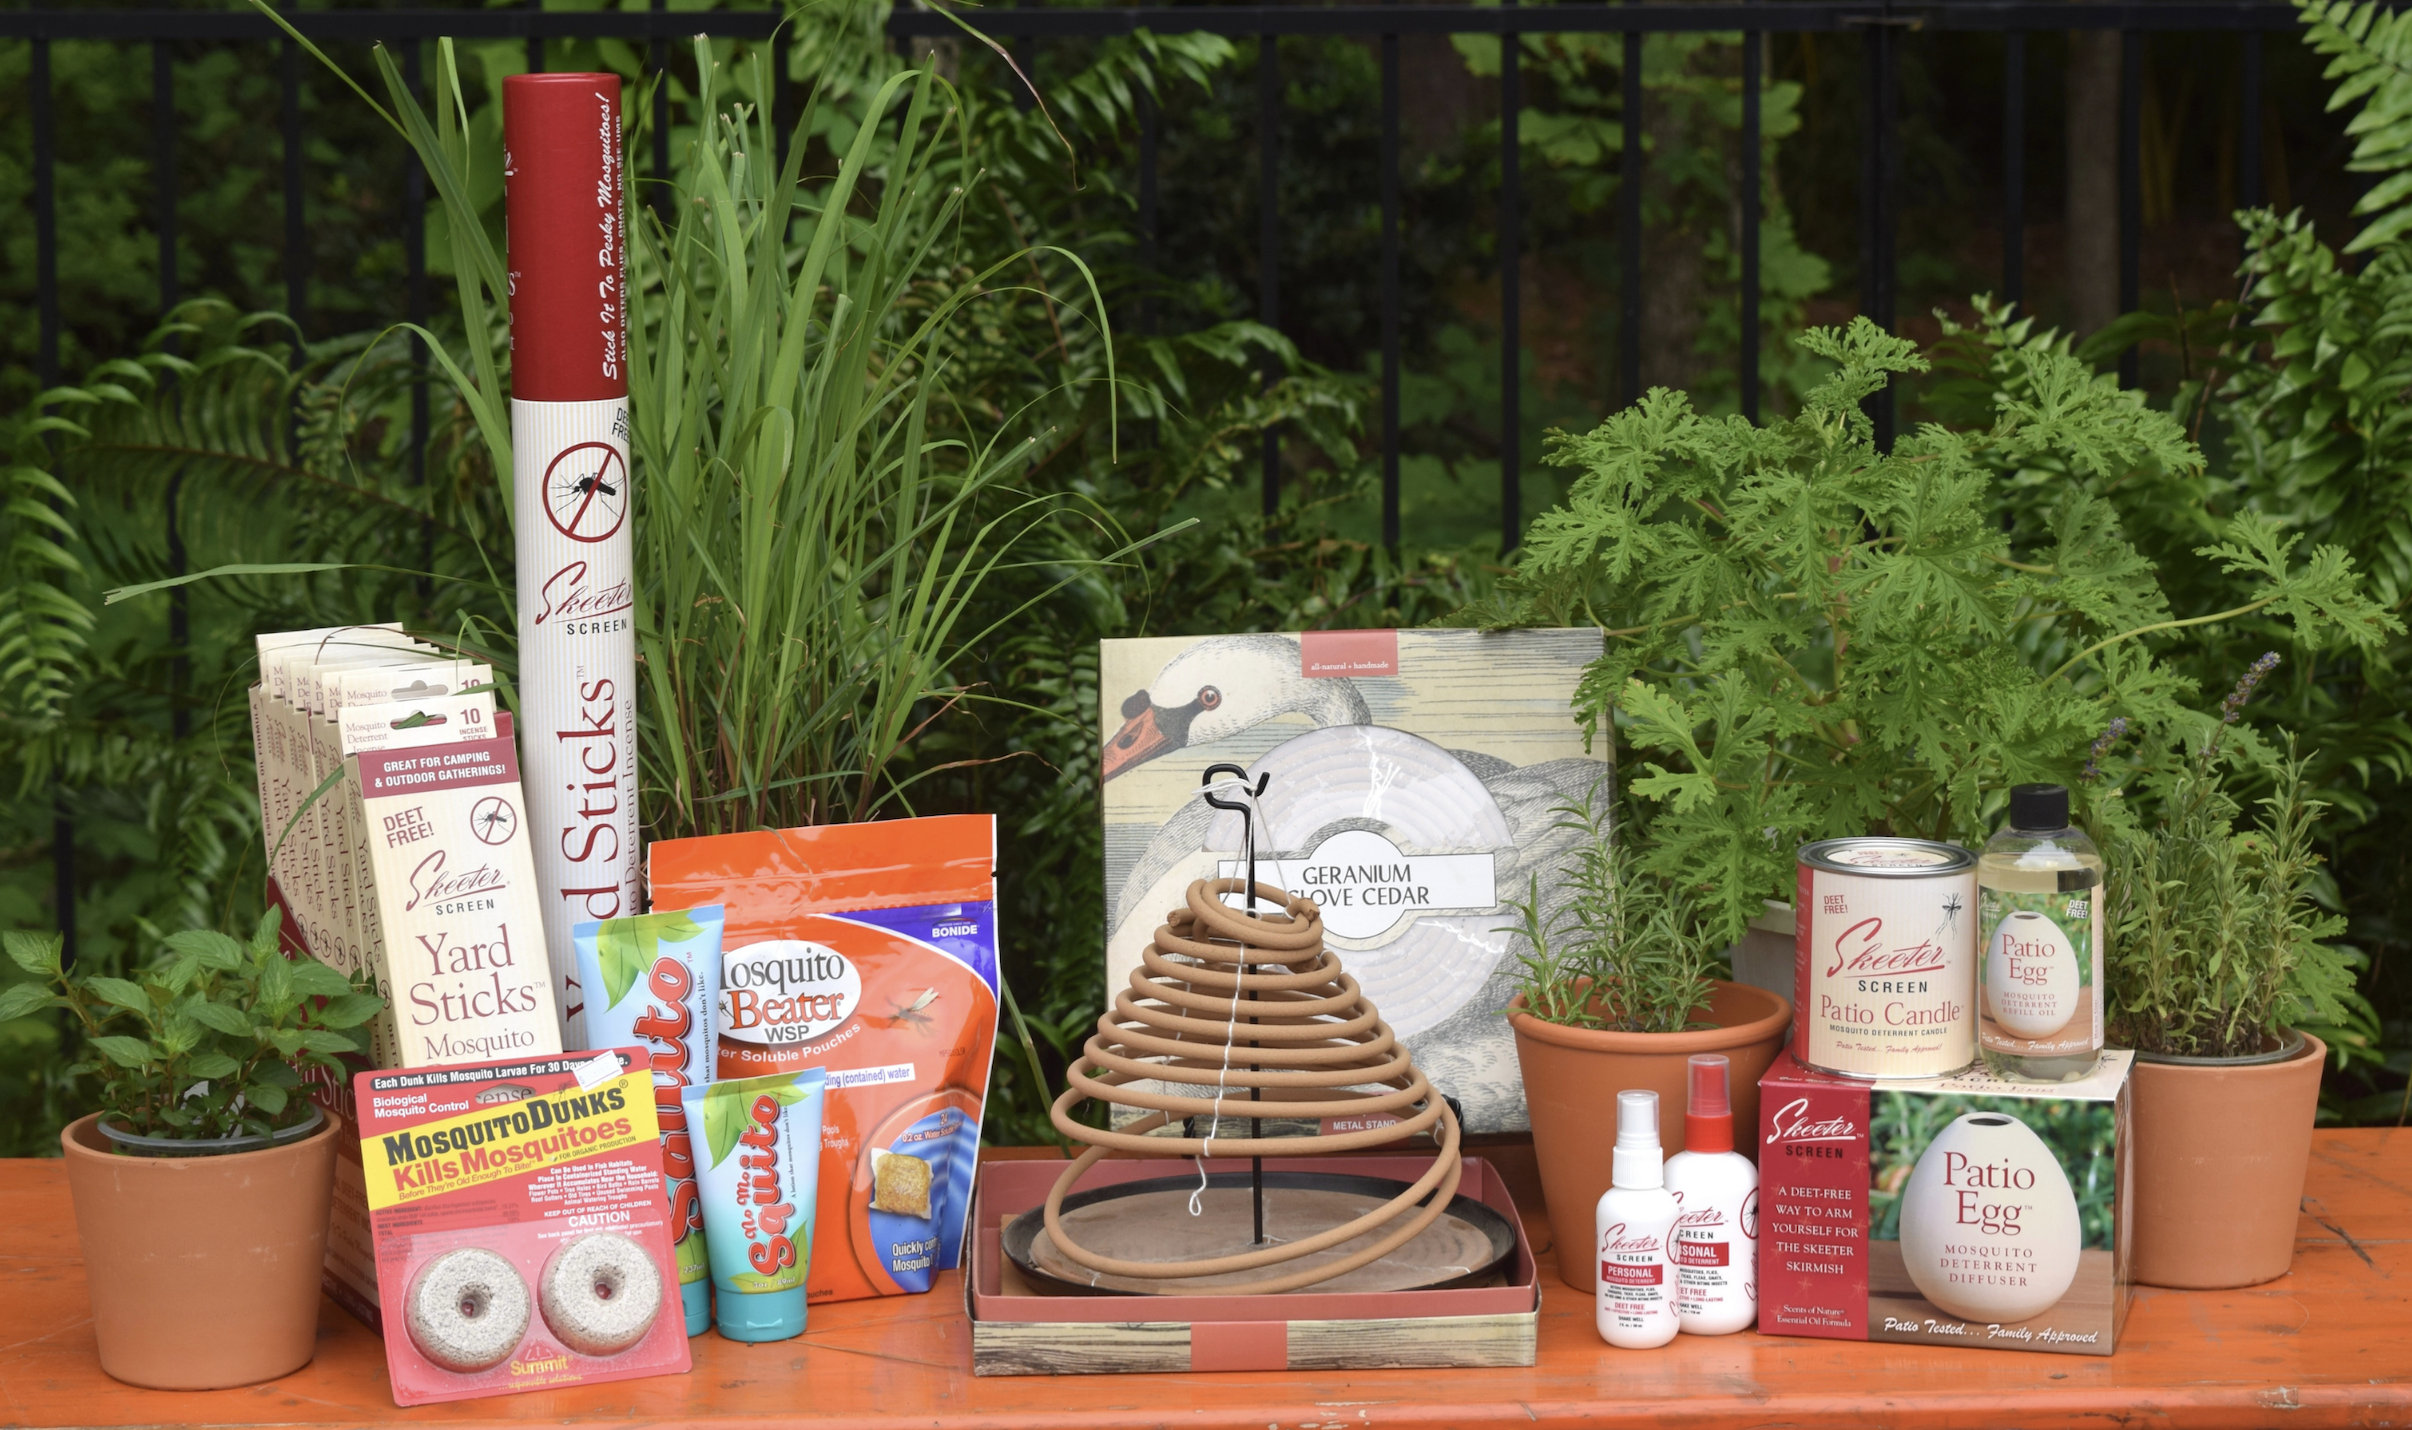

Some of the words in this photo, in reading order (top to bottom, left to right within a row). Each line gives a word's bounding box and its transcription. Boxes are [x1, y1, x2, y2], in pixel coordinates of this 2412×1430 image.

[595, 92, 615, 208] Mosquitoes!
[599, 212, 615, 268] Pesky
[599, 274, 615, 298] To
[600, 303, 615, 323] It
[601, 330, 617, 380] Stick
[535, 560, 632, 625] Skeeter
[566, 618, 627, 636] SCREEN
[1310, 662, 1347, 671] all-natural
[1353, 660, 1389, 669] handmade
[346, 690, 387, 700] Mosquito
[460, 708, 481, 725] 10
[345, 722, 386, 733] Mosquito
[459, 726, 488, 735] INCENSE
[346, 733, 388, 744] Deterrent
[622, 699, 634, 779] Incense
[383, 759, 417, 772] GREAT
[420, 756, 441, 768] FOR
[443, 751, 490, 766] CAMPING
[556, 678, 619, 863] Sticks
[374, 777, 383, 788] &
[385, 771, 436, 787] OUTDOOR
[438, 764, 506, 781] GATHERINGS!
[383, 806, 424, 832] DEET
[386, 821, 434, 849] FREE!
[624, 783, 638, 886] Deterrent
[406, 850, 506, 912] Skeeter
[1302, 864, 1411, 885] GERANIUM
[357, 838, 374, 890] Yard
[366, 896, 383, 963] Sticks
[1362, 886, 1430, 906] CEDAR
[1824, 895, 1844, 905] DEET
[2068, 899, 2088, 910] DEET
[435, 898, 495, 916] SCREEN
[1824, 904, 1848, 915] FREE!
[2066, 908, 2088, 919] FREE!
[931, 924, 978, 938] BONIDE
[415, 923, 515, 976] Yard
[1827, 917, 1945, 979] Skeeter
[2001, 933, 2055, 957] Patio
[2008, 957, 2047, 986] Egg
[1858, 980, 1928, 994] SCREEN
[2003, 991, 2055, 1001] MOSQUITO
[409, 971, 537, 1026] Sticks
[2001, 999, 2058, 1008] DETERRENT
[726, 990, 845, 1030] Beater
[1820, 994, 1874, 1025] Patio
[1884, 1000, 1960, 1026] Candle
[2003, 1008, 2034, 1016] REFILL
[764, 1025, 810, 1043] WSP
[1829, 1024, 1869, 1036] MOSQUITO
[1871, 1028, 1918, 1037] DETERRENT
[1921, 1027, 1947, 1036] CANDLE
[423, 1028, 535, 1060] Mosquito
[740, 1049, 799, 1063] Soluble
[802, 1023, 861, 1058] Pouches
[1836, 1041, 1853, 1049] Patio
[1885, 1045, 1909, 1054] Family
[1911, 1043, 1943, 1053] Approved!
[2027, 1041, 2055, 1051] Family
[2057, 1037, 2089, 1050] Approved
[374, 1077, 398, 1089] Each
[400, 1074, 425, 1086] Dunk
[426, 1073, 448, 1084] Kills
[450, 1068, 493, 1083] Mosquito
[495, 1066, 528, 1078] Larvae
[530, 1063, 546, 1074] For
[548, 1062, 560, 1072] 30
[842, 1069, 886, 1087] (contained)
[886, 1067, 910, 1079] water
[373, 1093, 427, 1108] Biological
[374, 1106, 426, 1118] Mosquito
[428, 1100, 469, 1113] Control
[822, 1125, 840, 1135] Pools
[1333, 1120, 1364, 1131] METAL
[1365, 1119, 1397, 1129] STAND
[1766, 1098, 1856, 1144] Skeeter
[559, 1152, 572, 1160] FOR
[572, 1145, 599, 1157] ORGANIC
[599, 1135, 637, 1150] PRODUCTION
[823, 1137, 849, 1149] Troughs
[1785, 1145, 1843, 1158] SCREEN
[392, 1158, 460, 1191] Kills
[459, 1117, 632, 1174] Mosquitoes
[550, 1167, 562, 1175] Can
[572, 1164, 587, 1172] Used
[608, 1160, 633, 1168] Habitats
[1943, 1151, 2035, 1190] Patio
[399, 1188, 425, 1201] Before
[426, 1181, 455, 1194] They're
[456, 1175, 470, 1186] Old
[471, 1169, 502, 1183] Enough
[503, 1166, 513, 1175] To
[739, 1094, 796, 1276] Squito
[1778, 1186, 1787, 1196] A
[1790, 1187, 1852, 1200] DEET-FREE
[544, 1209, 562, 1218] KEEP
[562, 1208, 576, 1216] OUT
[586, 1204, 609, 1213] REACH
[619, 1200, 652, 1209] CHILDREN
[1775, 1204, 1801, 1215] WAY
[1804, 1206, 1822, 1217] TO
[1825, 1208, 1853, 1219] ARM
[1955, 1189, 2022, 1236] Egg
[568, 1210, 631, 1228] CAUTION
[1601, 1222, 1660, 1253] Skeeter
[1772, 1222, 1832, 1237] YOURSELF
[1835, 1227, 1859, 1238] FOR
[892, 1240, 923, 1257] Quickly
[1776, 1241, 1800, 1253] THE
[1803, 1243, 1854, 1257] SKEETER
[1944, 1244, 2033, 1258] MOSQUITO
[892, 1256, 930, 1272] Mosquito
[1616, 1254, 1653, 1262] SCREEN
[1940, 1258, 2037, 1273] DETERRENT
[1607, 1265, 1653, 1278] PERSONAL
[1786, 1261, 1844, 1275] SKIRMISH
[1949, 1273, 2028, 1287] DIFFUSER
[1614, 1302, 1629, 1310] DEET
[1783, 1304, 1807, 1313] Scents
[1808, 1305, 1816, 1314] of
[1777, 1314, 1808, 1324] Essential
[1809, 1315, 1821, 1325] Oil
[1822, 1317, 1852, 1328] Formula
[1884, 1317, 1919, 1332] Patio
[1924, 1319, 1980, 1336] Tested...
[1986, 1323, 2032, 1342] Family
[2036, 1328, 2098, 1344] Approved
[510, 1355, 568, 1376] Summit
